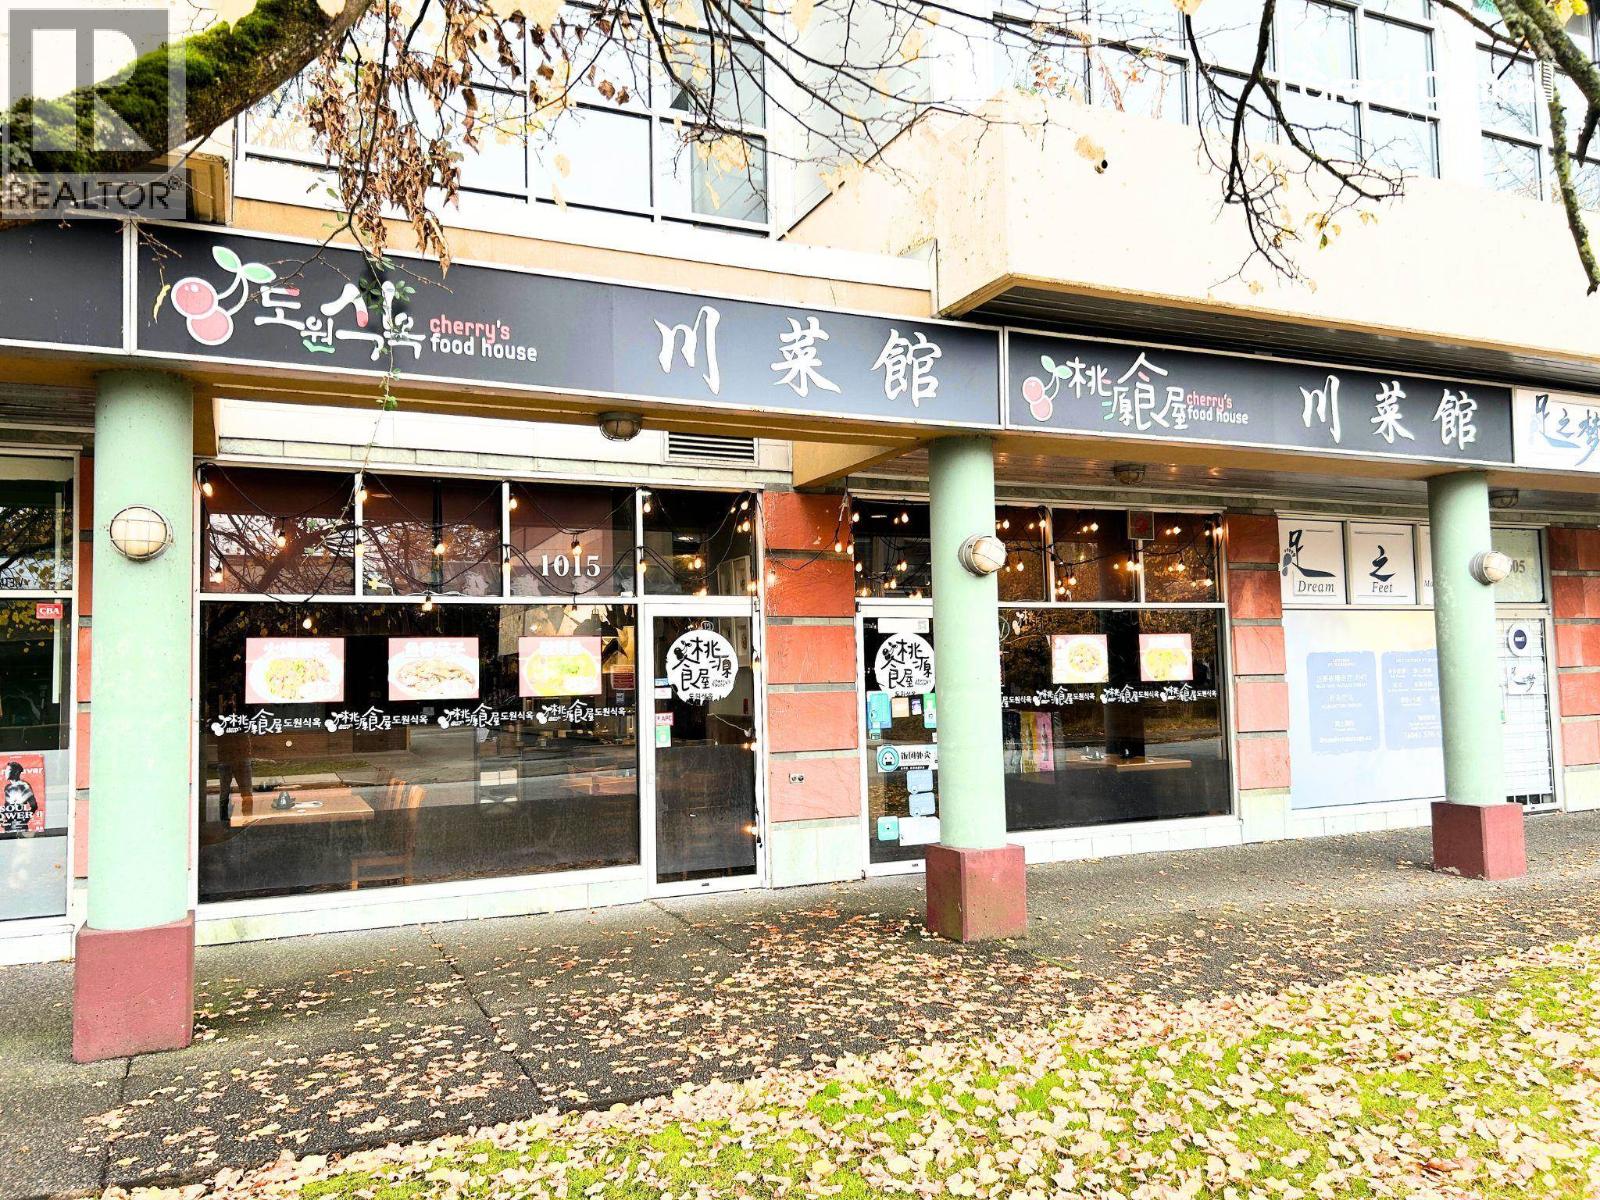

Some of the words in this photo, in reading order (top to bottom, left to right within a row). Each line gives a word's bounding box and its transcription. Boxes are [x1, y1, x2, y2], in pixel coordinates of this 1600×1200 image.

[254, 280, 427, 361] 도원식옥
[429, 314, 511, 344] cherry's
[430, 333, 475, 356] food
[482, 337, 538, 362] house
[652, 305, 943, 408] 川菜館
[1066, 352, 1189, 431] 桃源食屋
[1186, 391, 1233, 413] cherry's
[1187, 405, 1213, 421] food
[1216, 409, 1249, 425] house
[1299, 374, 1478, 450] 川菜館
[541, 554, 601, 577] 1015
[1368, 545, 1396, 582] 之
[1510, 559, 1526, 573] 05
[1298, 580, 1335, 593] Dream
[1371, 581, 1393, 593] Feet
